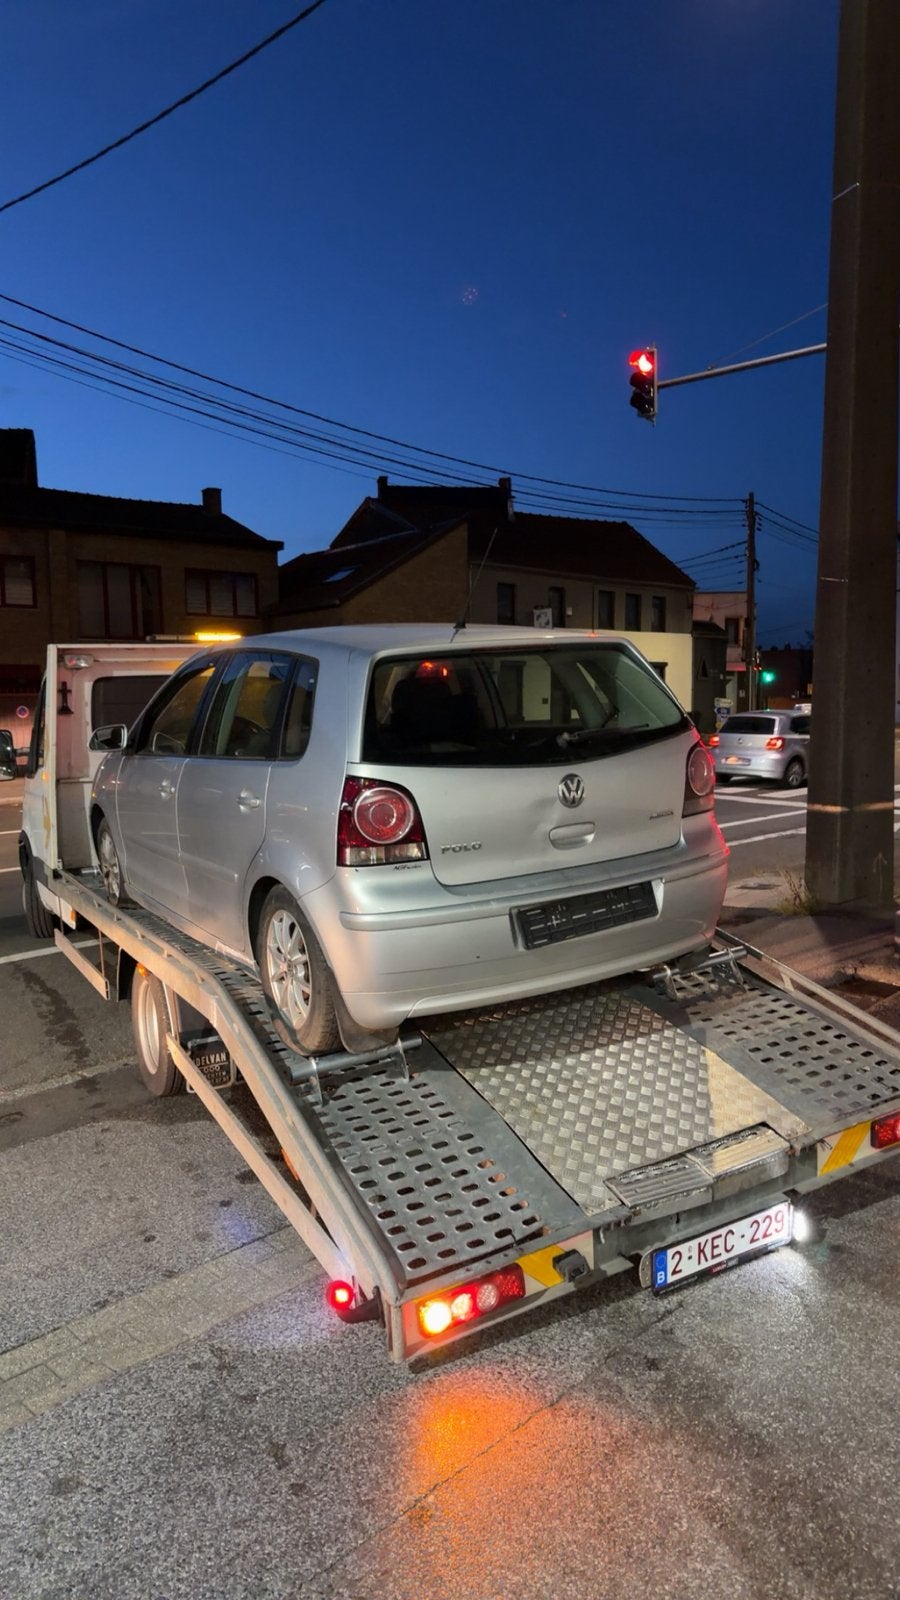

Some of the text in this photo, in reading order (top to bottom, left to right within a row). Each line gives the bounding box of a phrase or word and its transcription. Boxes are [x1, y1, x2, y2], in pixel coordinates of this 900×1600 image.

[558, 773, 585, 808] VW
[441, 842, 482, 854] POLO
[656, 1271, 665, 1284] B
